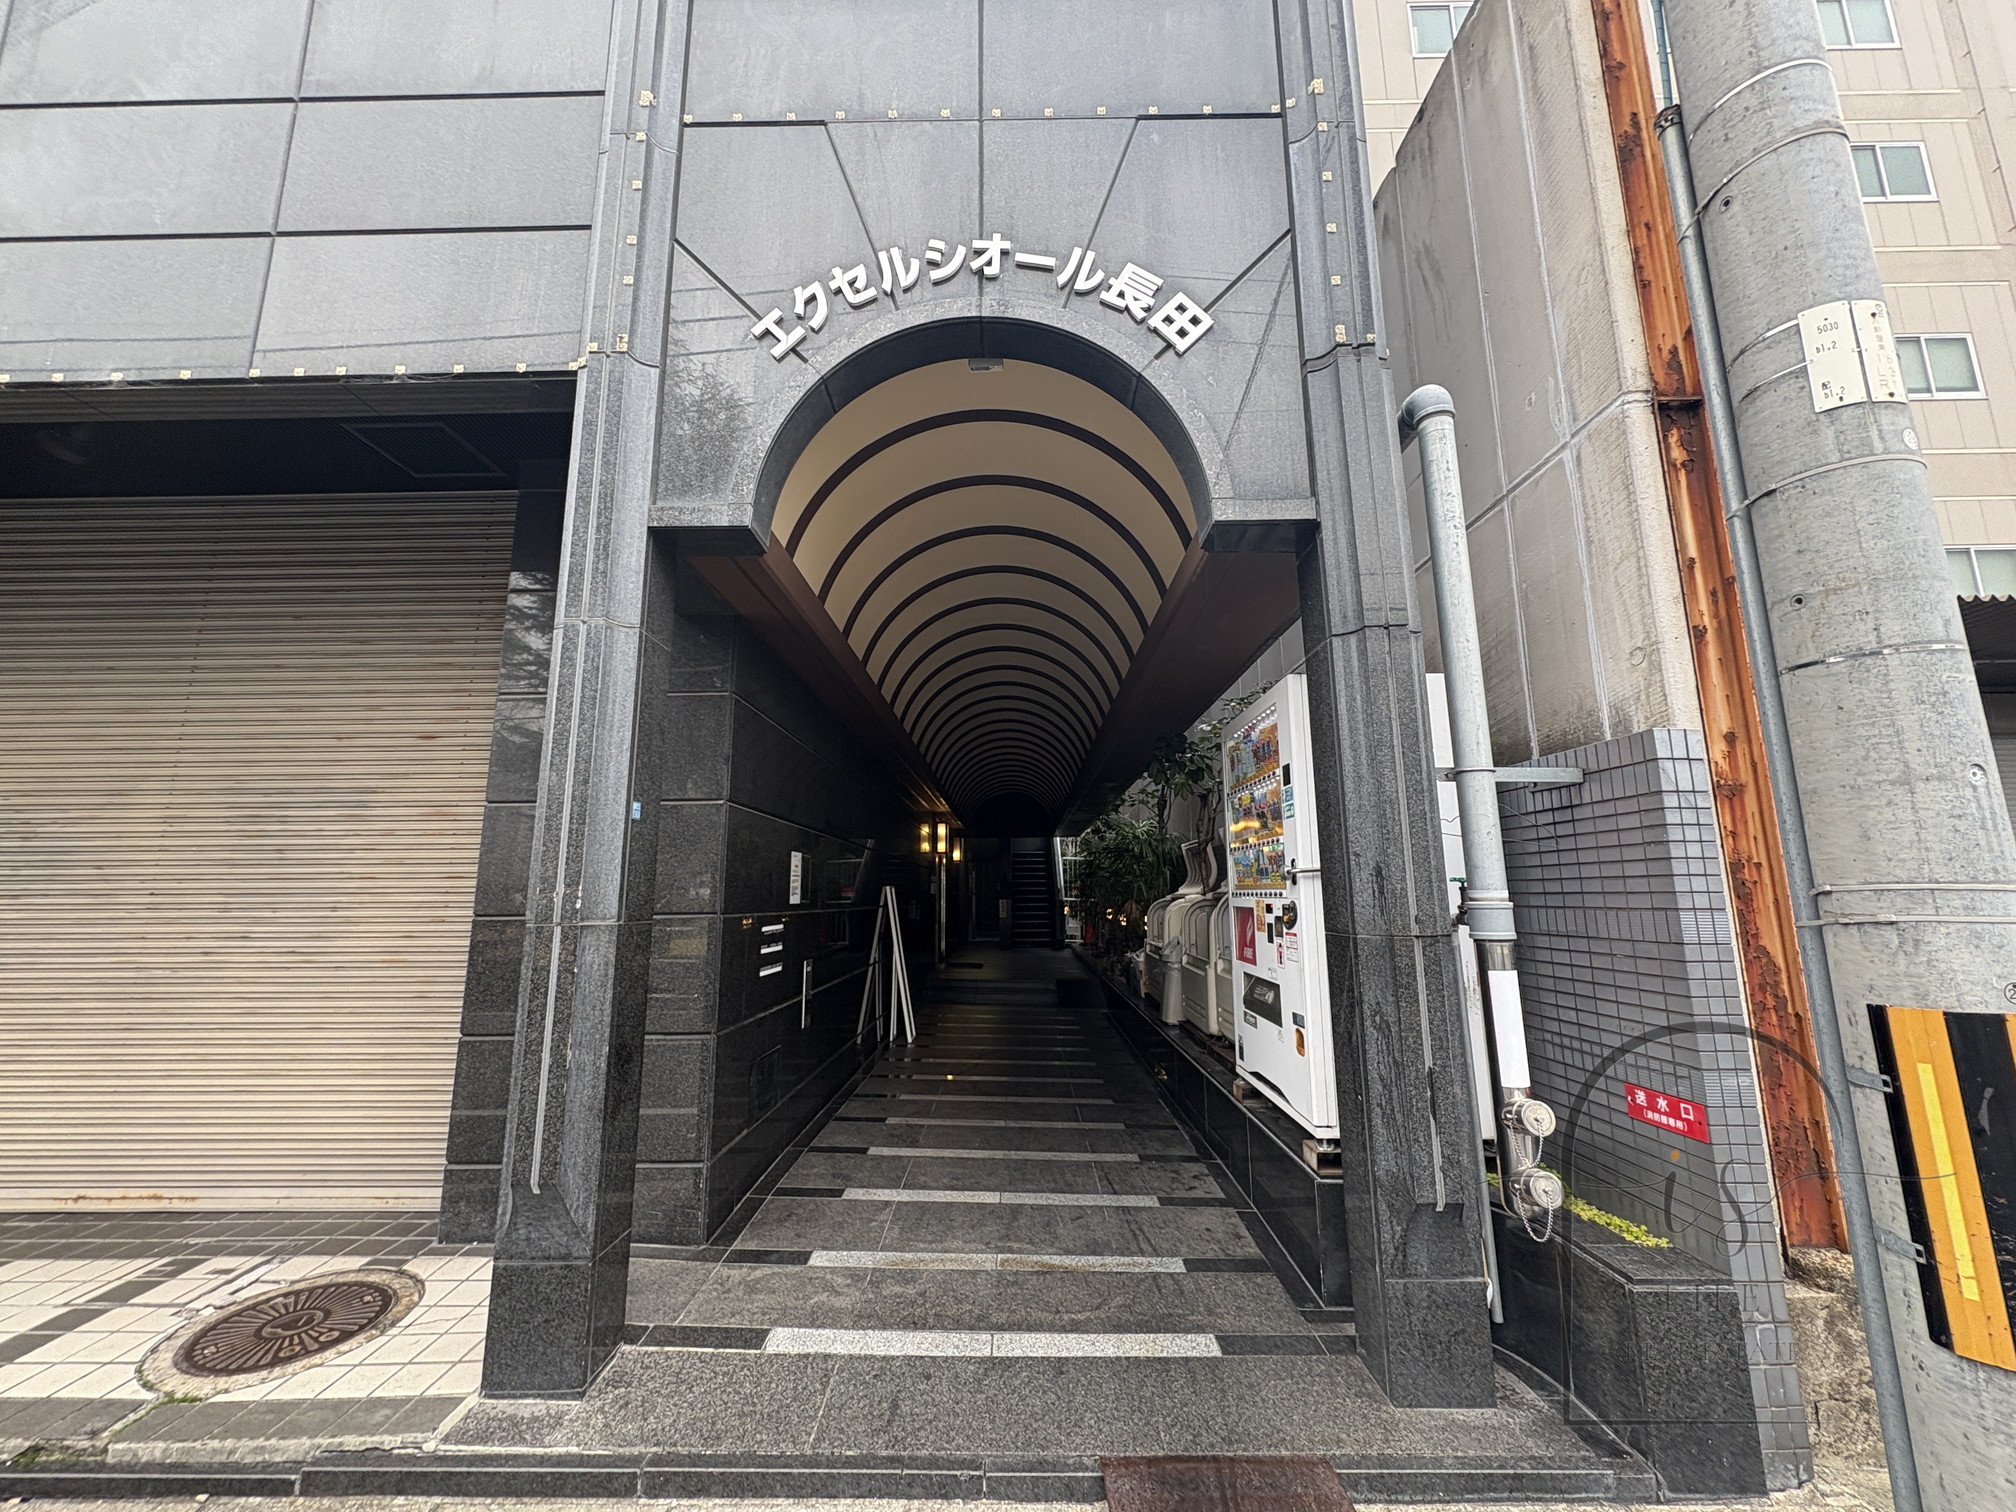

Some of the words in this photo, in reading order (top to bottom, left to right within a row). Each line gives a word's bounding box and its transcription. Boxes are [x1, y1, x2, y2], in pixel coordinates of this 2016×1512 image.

[750, 233, 1215, 356] エクセルシオール長田
[1816, 321, 1839, 335] 5030
[1634, 1088, 1695, 1121] 送水口
